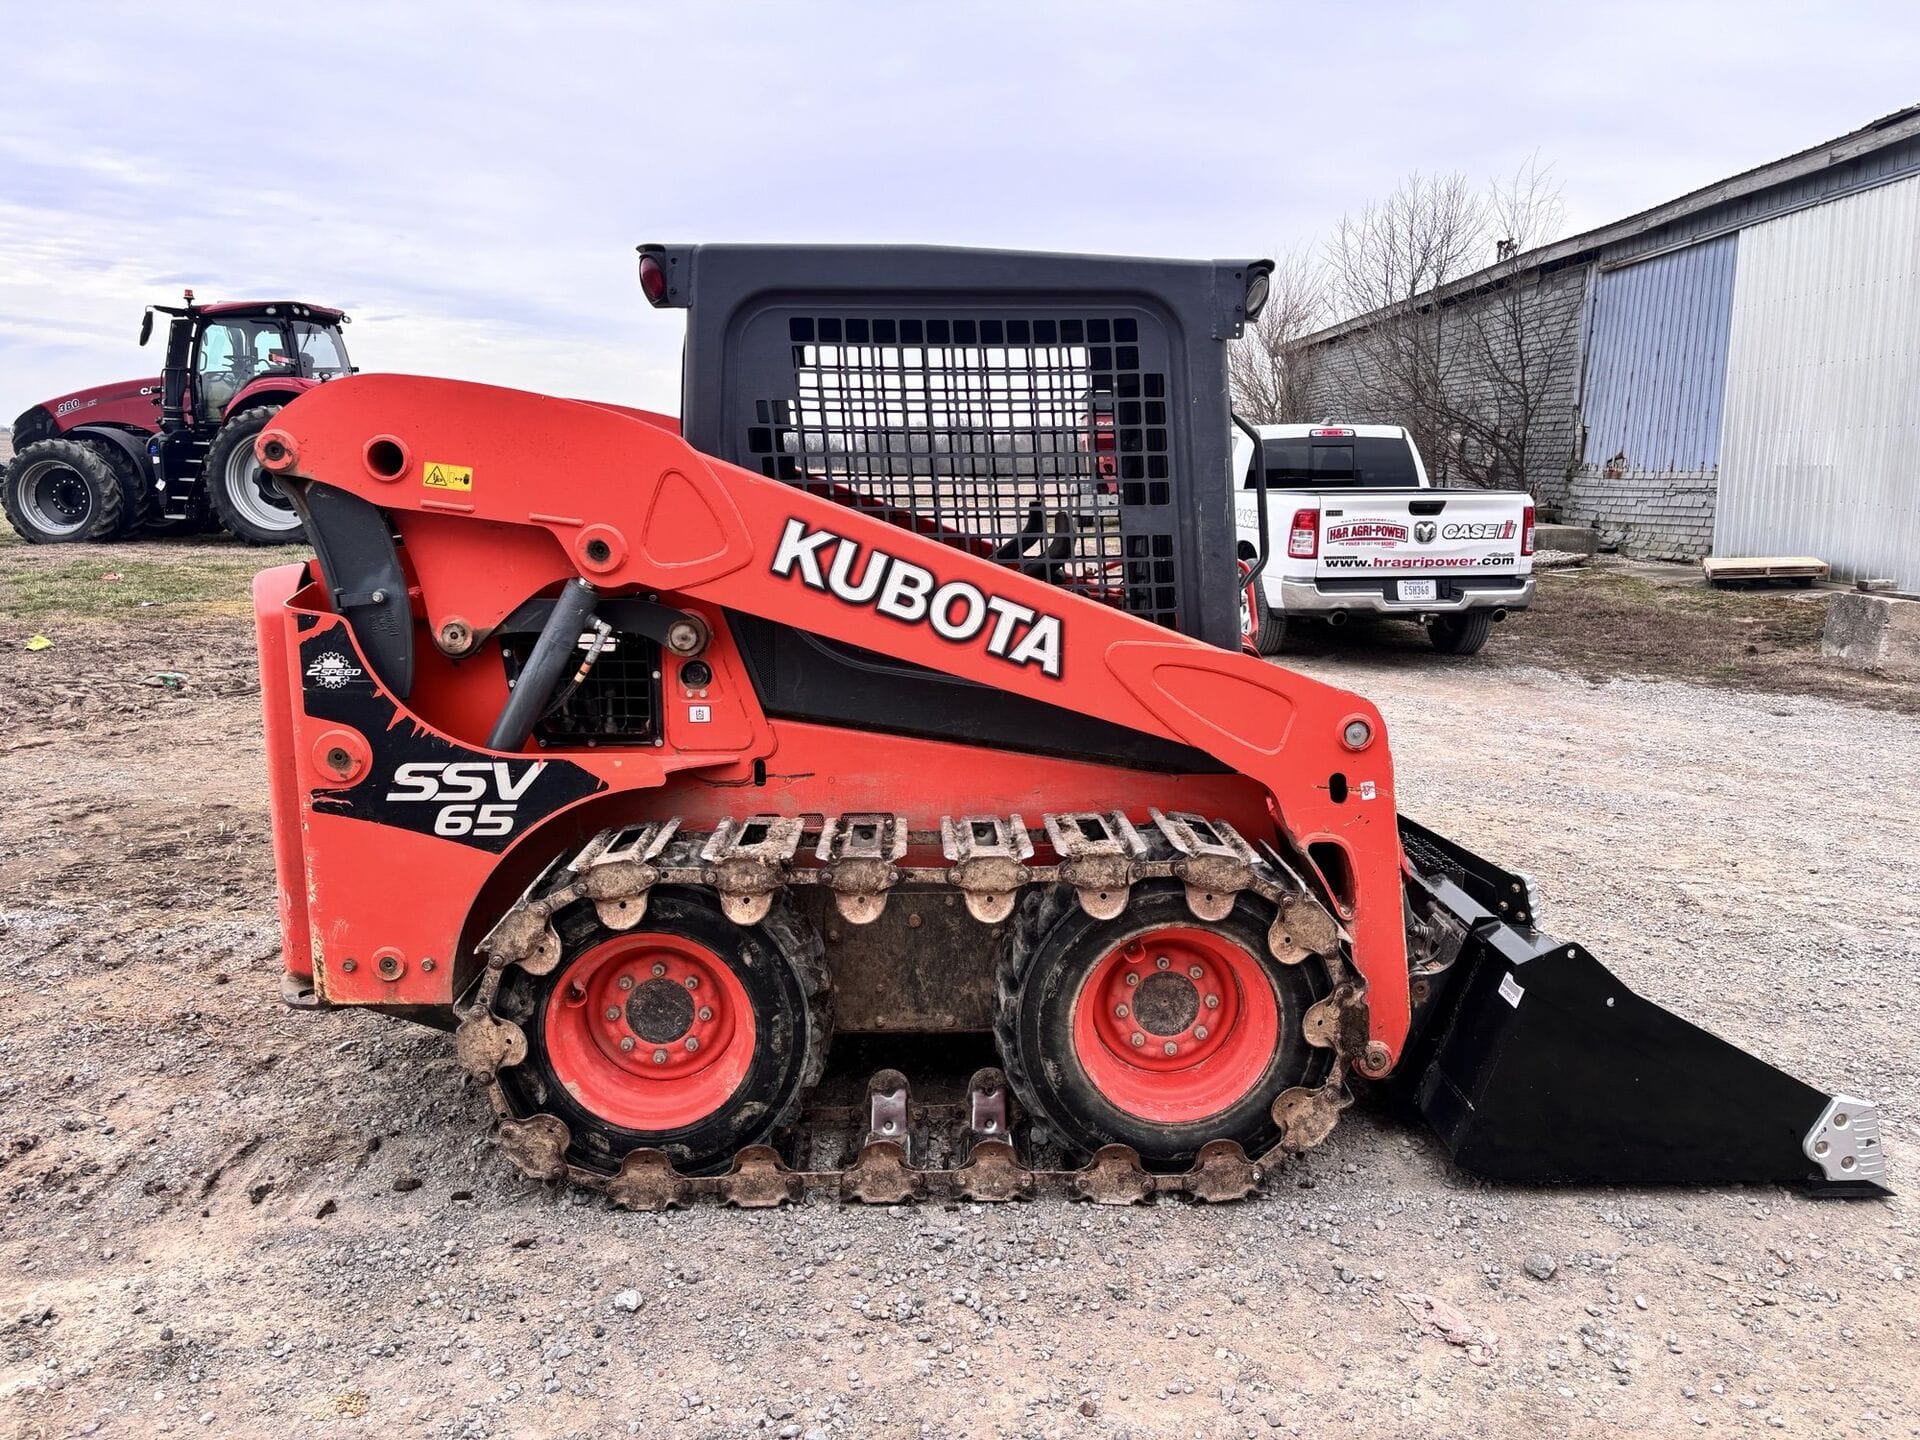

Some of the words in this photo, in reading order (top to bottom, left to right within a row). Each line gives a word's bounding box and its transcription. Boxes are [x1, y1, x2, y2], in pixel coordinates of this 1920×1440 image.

[57, 398, 80, 414] 380
[1329, 527, 1349, 541] H&R
[1351, 524, 1406, 540] AGRI-POWER
[1442, 523, 1499, 539] CASE
[1325, 556, 1515, 569] www.hragripower.com
[769, 515, 1064, 680] KUBOTA
[385, 761, 548, 802] SSV
[433, 803, 518, 837] 65
